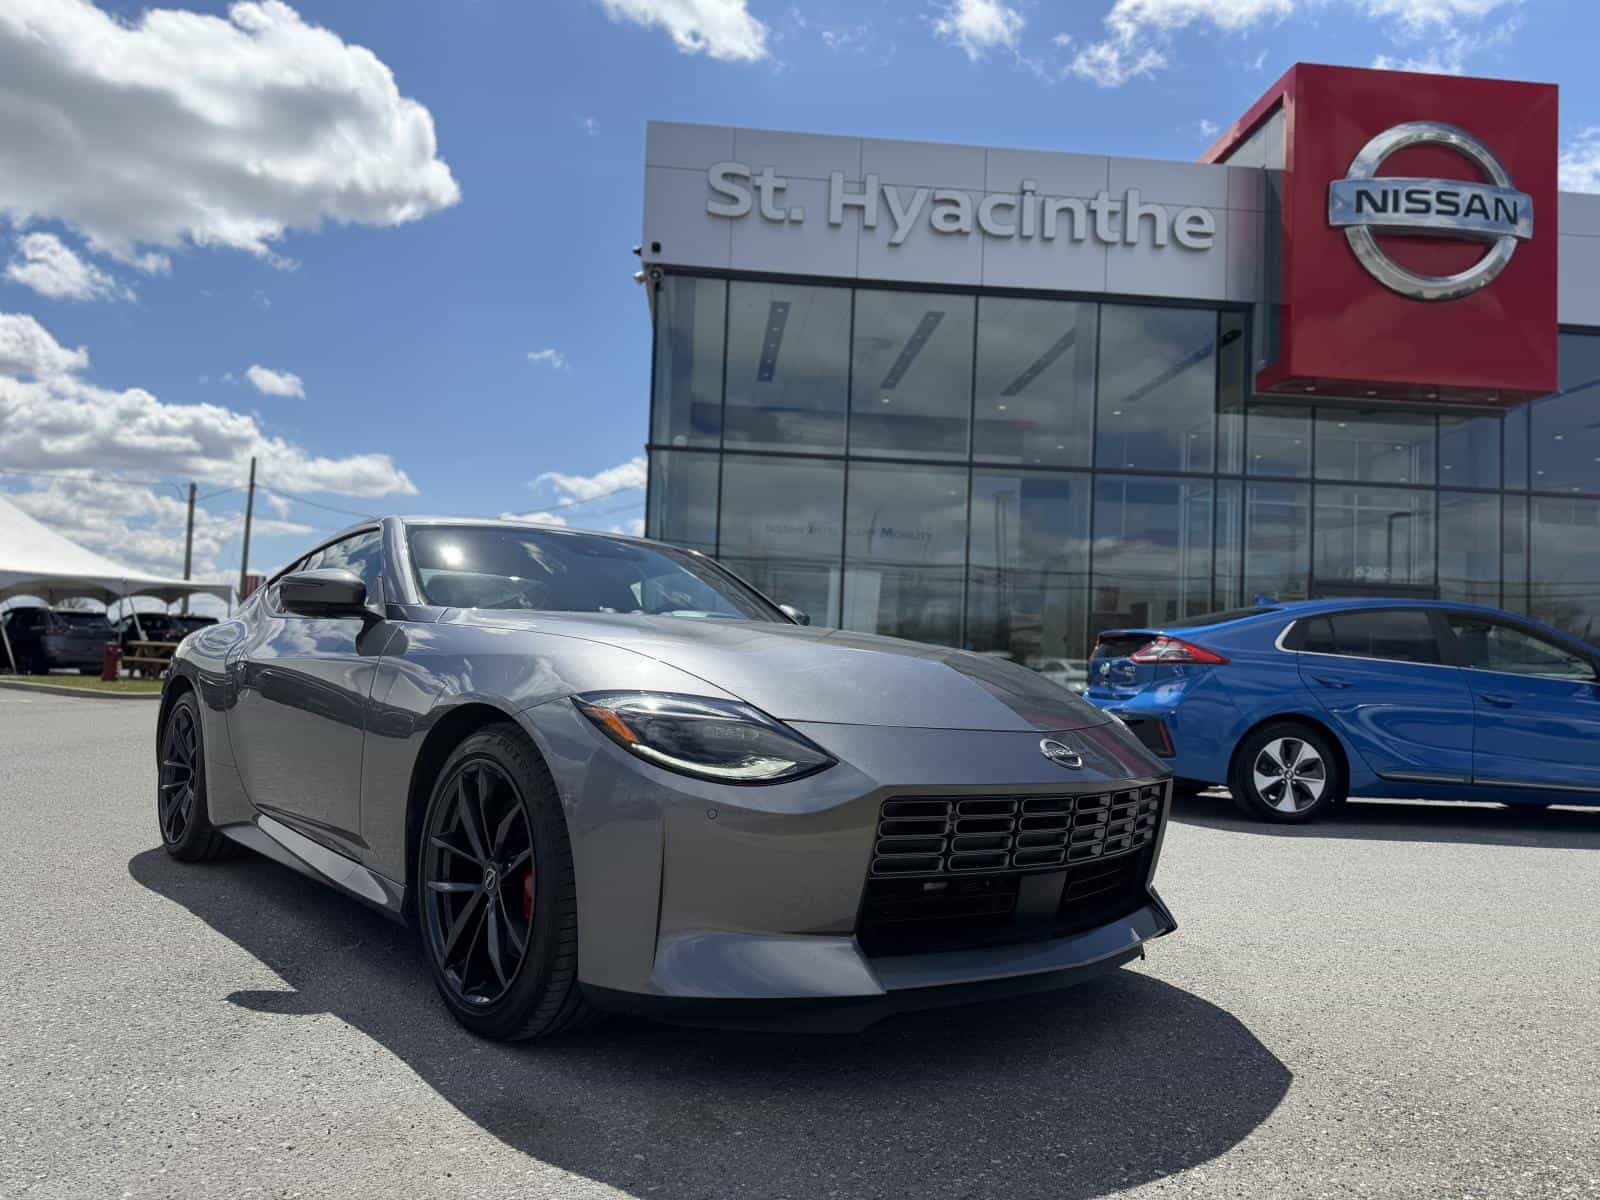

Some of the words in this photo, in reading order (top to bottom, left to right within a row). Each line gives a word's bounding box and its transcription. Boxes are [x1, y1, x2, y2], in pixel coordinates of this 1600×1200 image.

[706, 161, 804, 223] St.
[828, 170, 1217, 249] Hyacinthe
[1355, 189, 1518, 225] NISSAN
